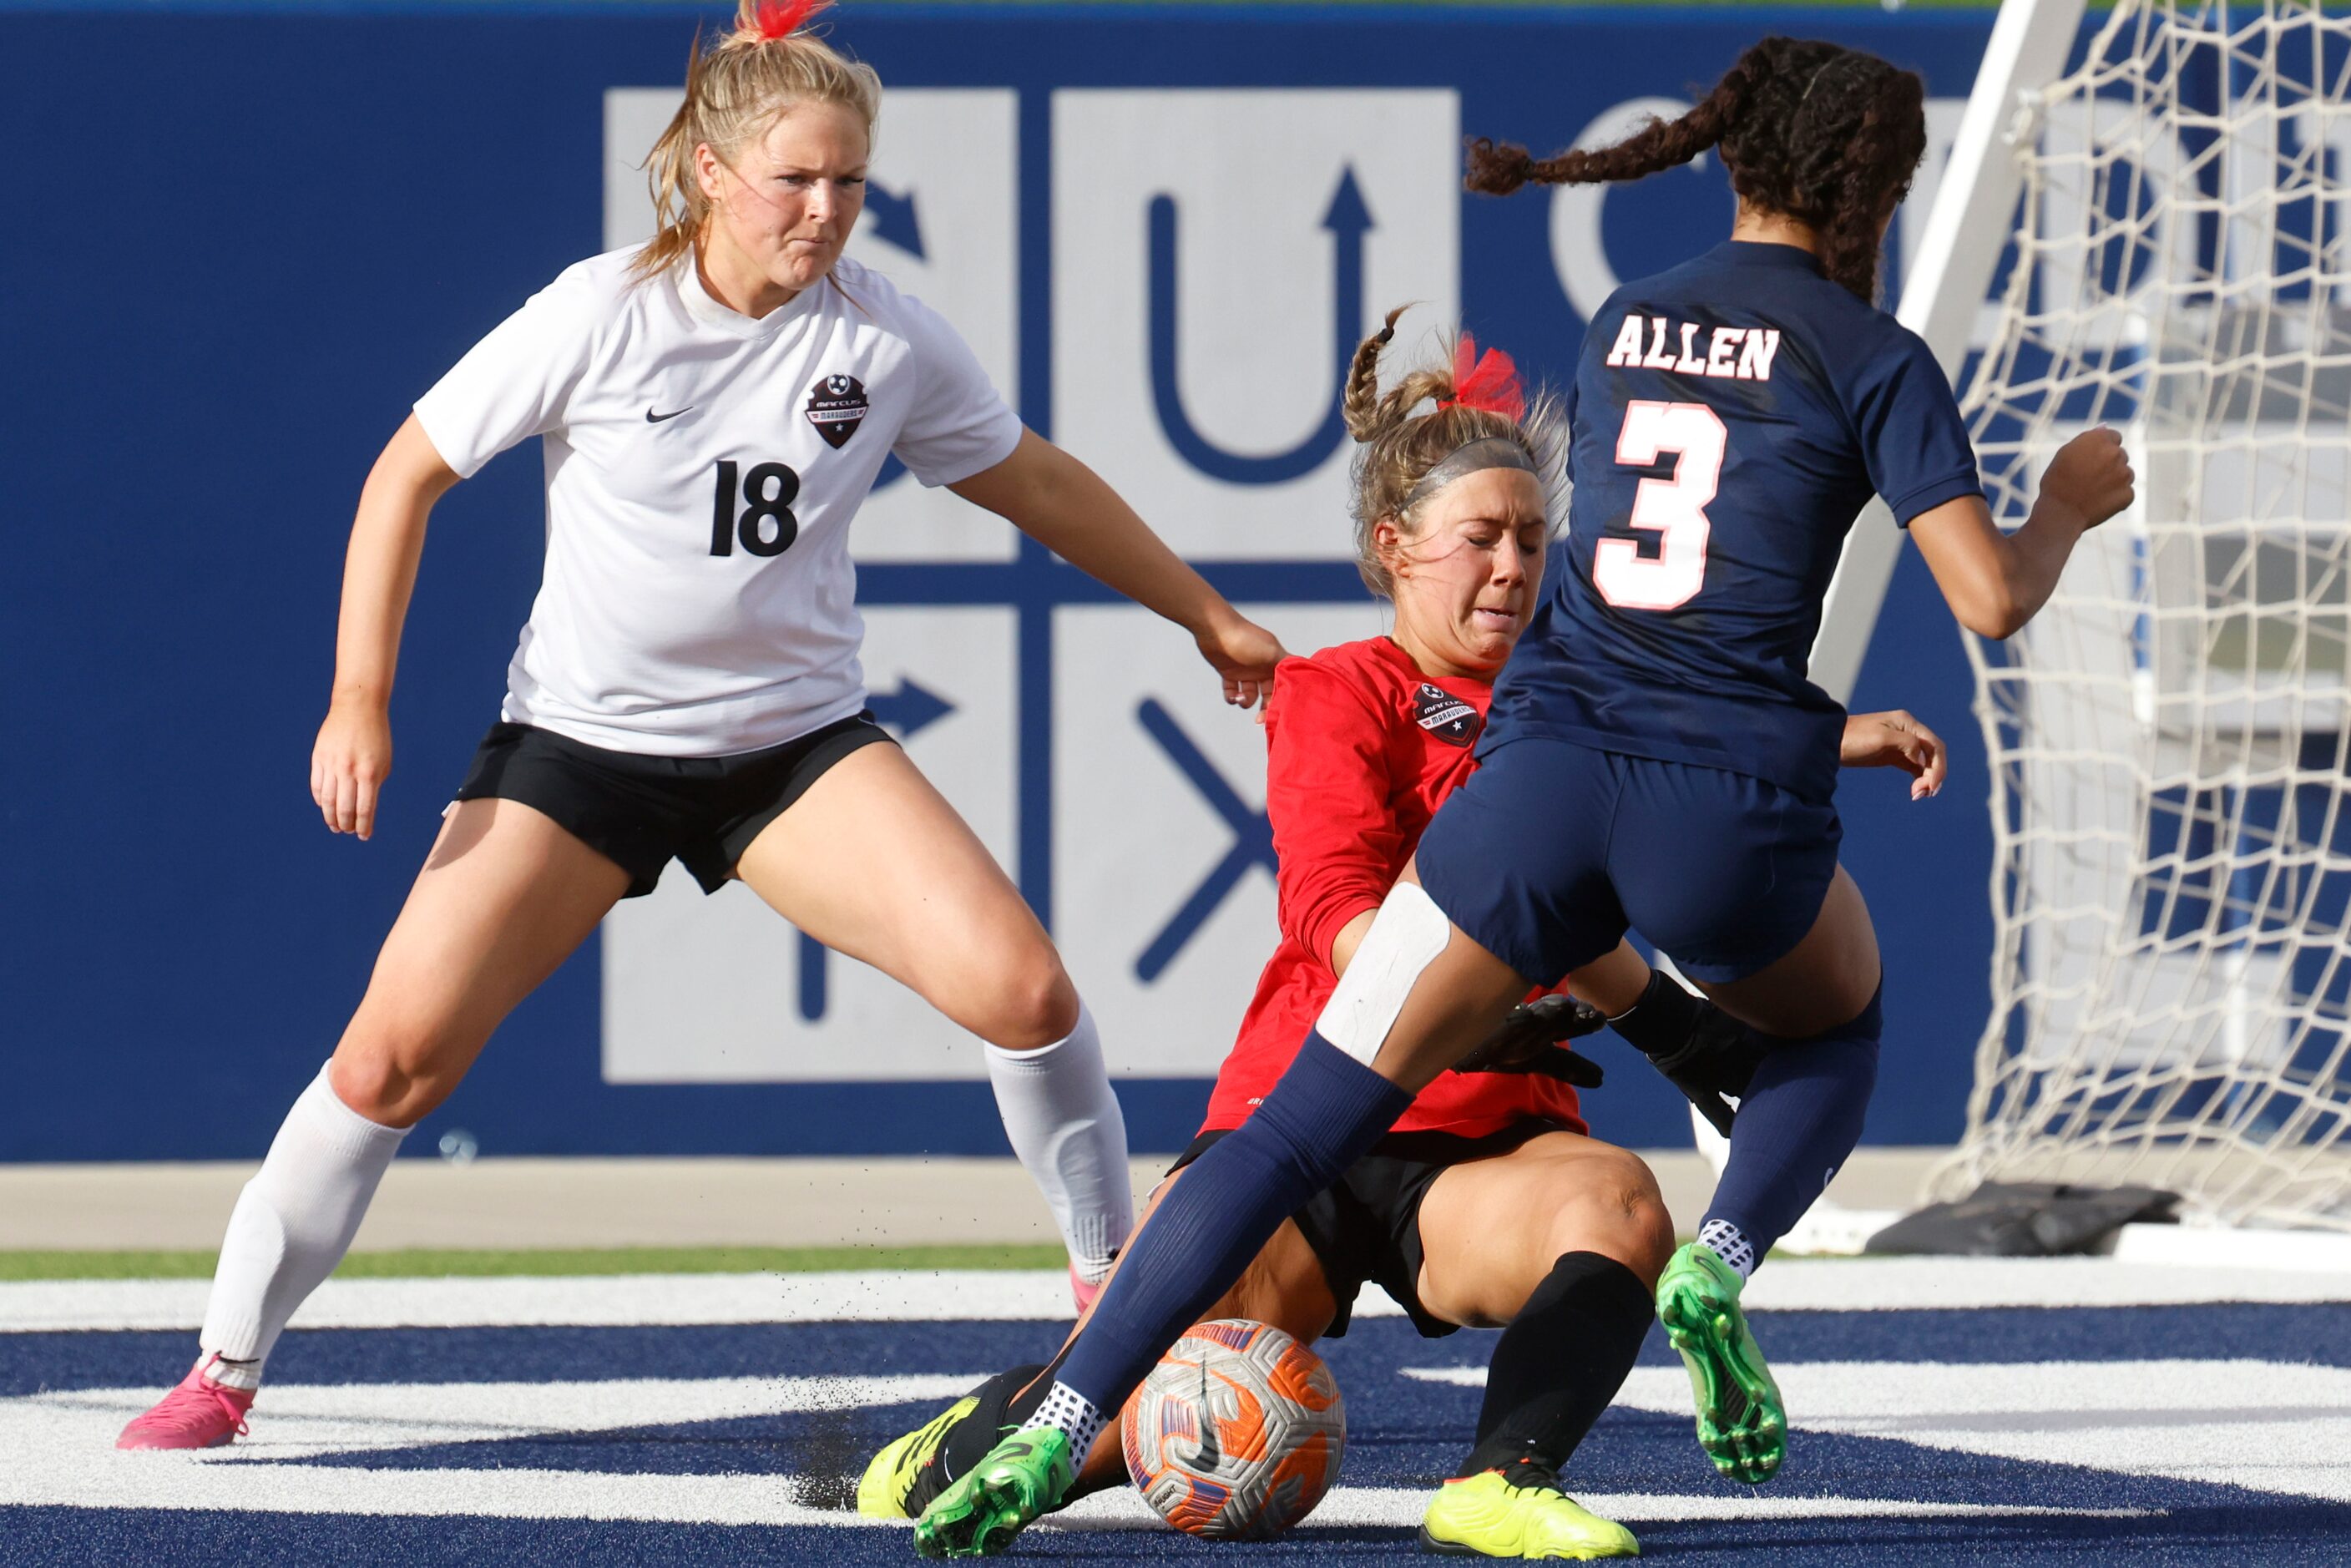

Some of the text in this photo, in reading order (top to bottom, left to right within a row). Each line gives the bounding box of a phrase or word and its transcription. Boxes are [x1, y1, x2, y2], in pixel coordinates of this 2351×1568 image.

[1605, 314, 1781, 382] ALLEN
[710, 460, 801, 558] 18
[1592, 399, 1728, 611] 3
